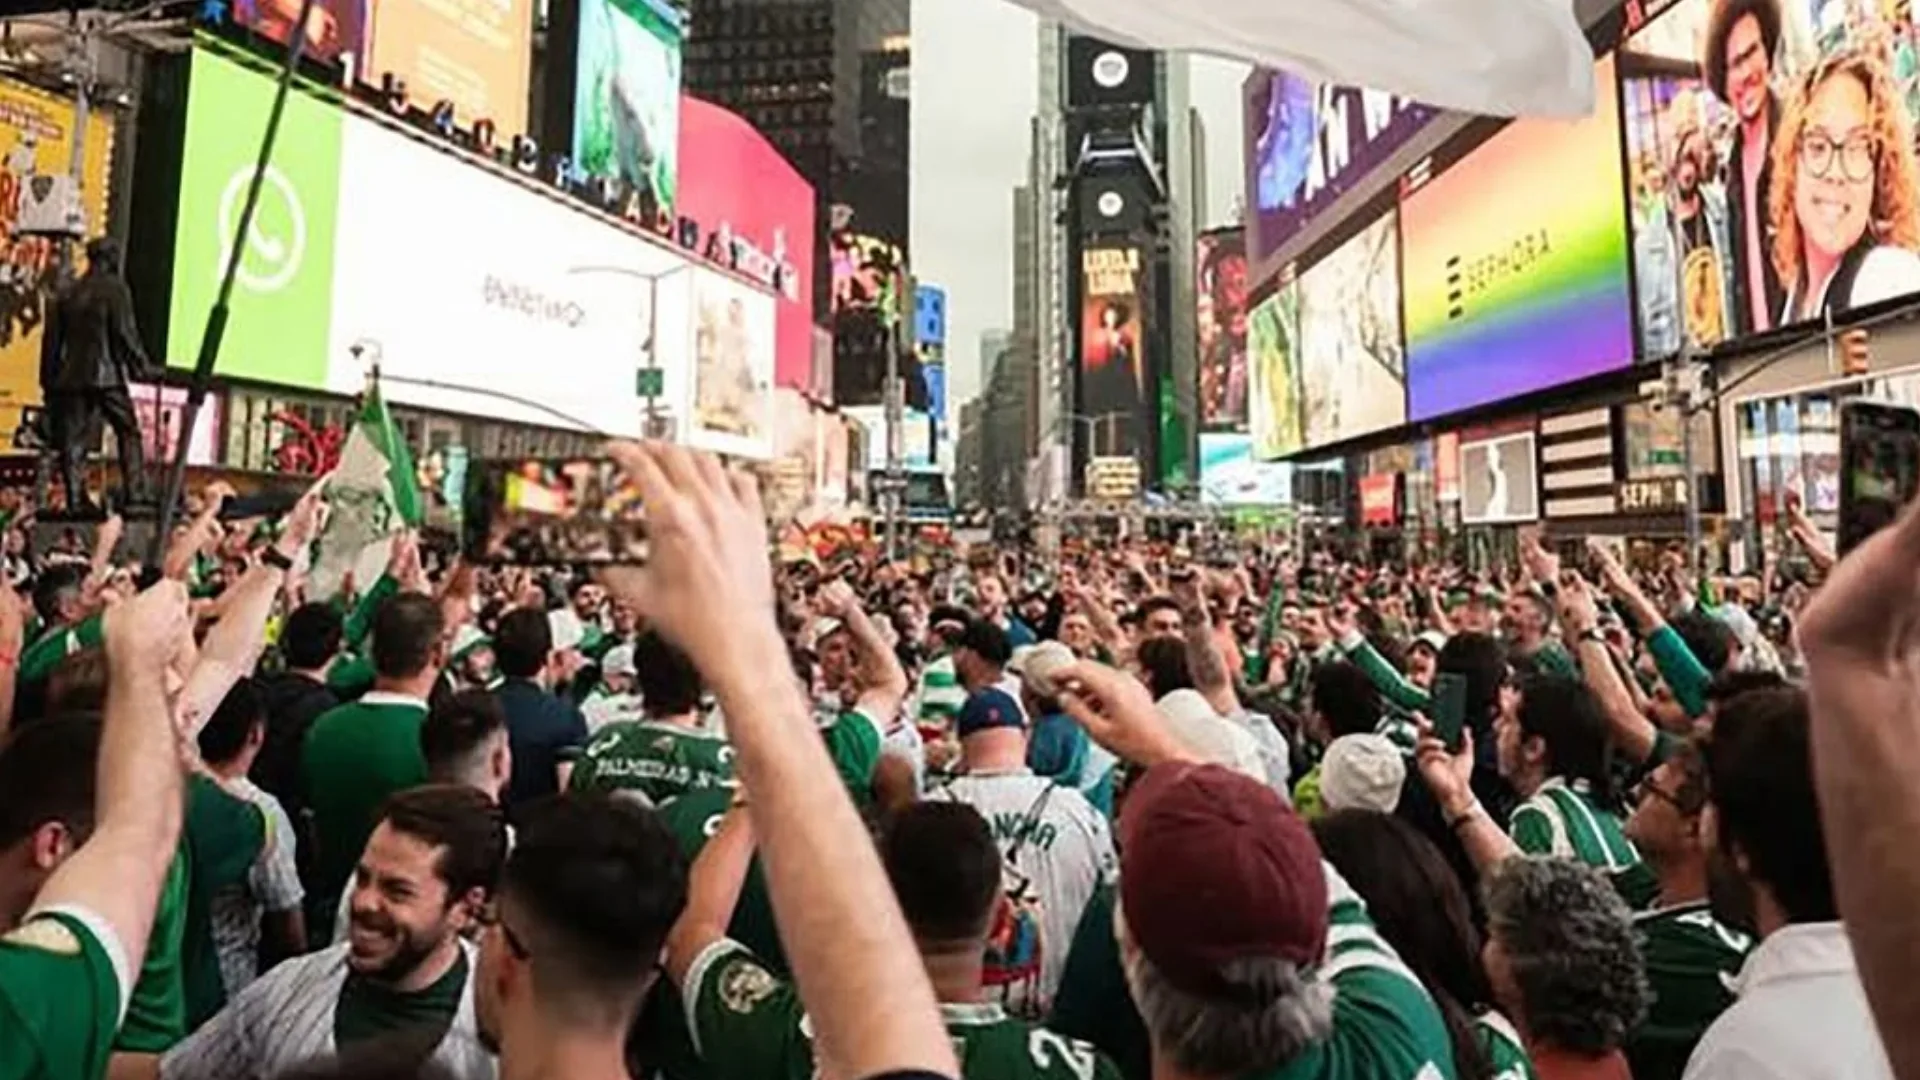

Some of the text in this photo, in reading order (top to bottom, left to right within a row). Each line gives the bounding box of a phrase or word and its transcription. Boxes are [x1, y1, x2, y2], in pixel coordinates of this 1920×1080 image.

[339, 52, 498, 158] 1540
[1466, 229, 1552, 294] SEPHORA
[1621, 480, 1687, 509] SEPHR
